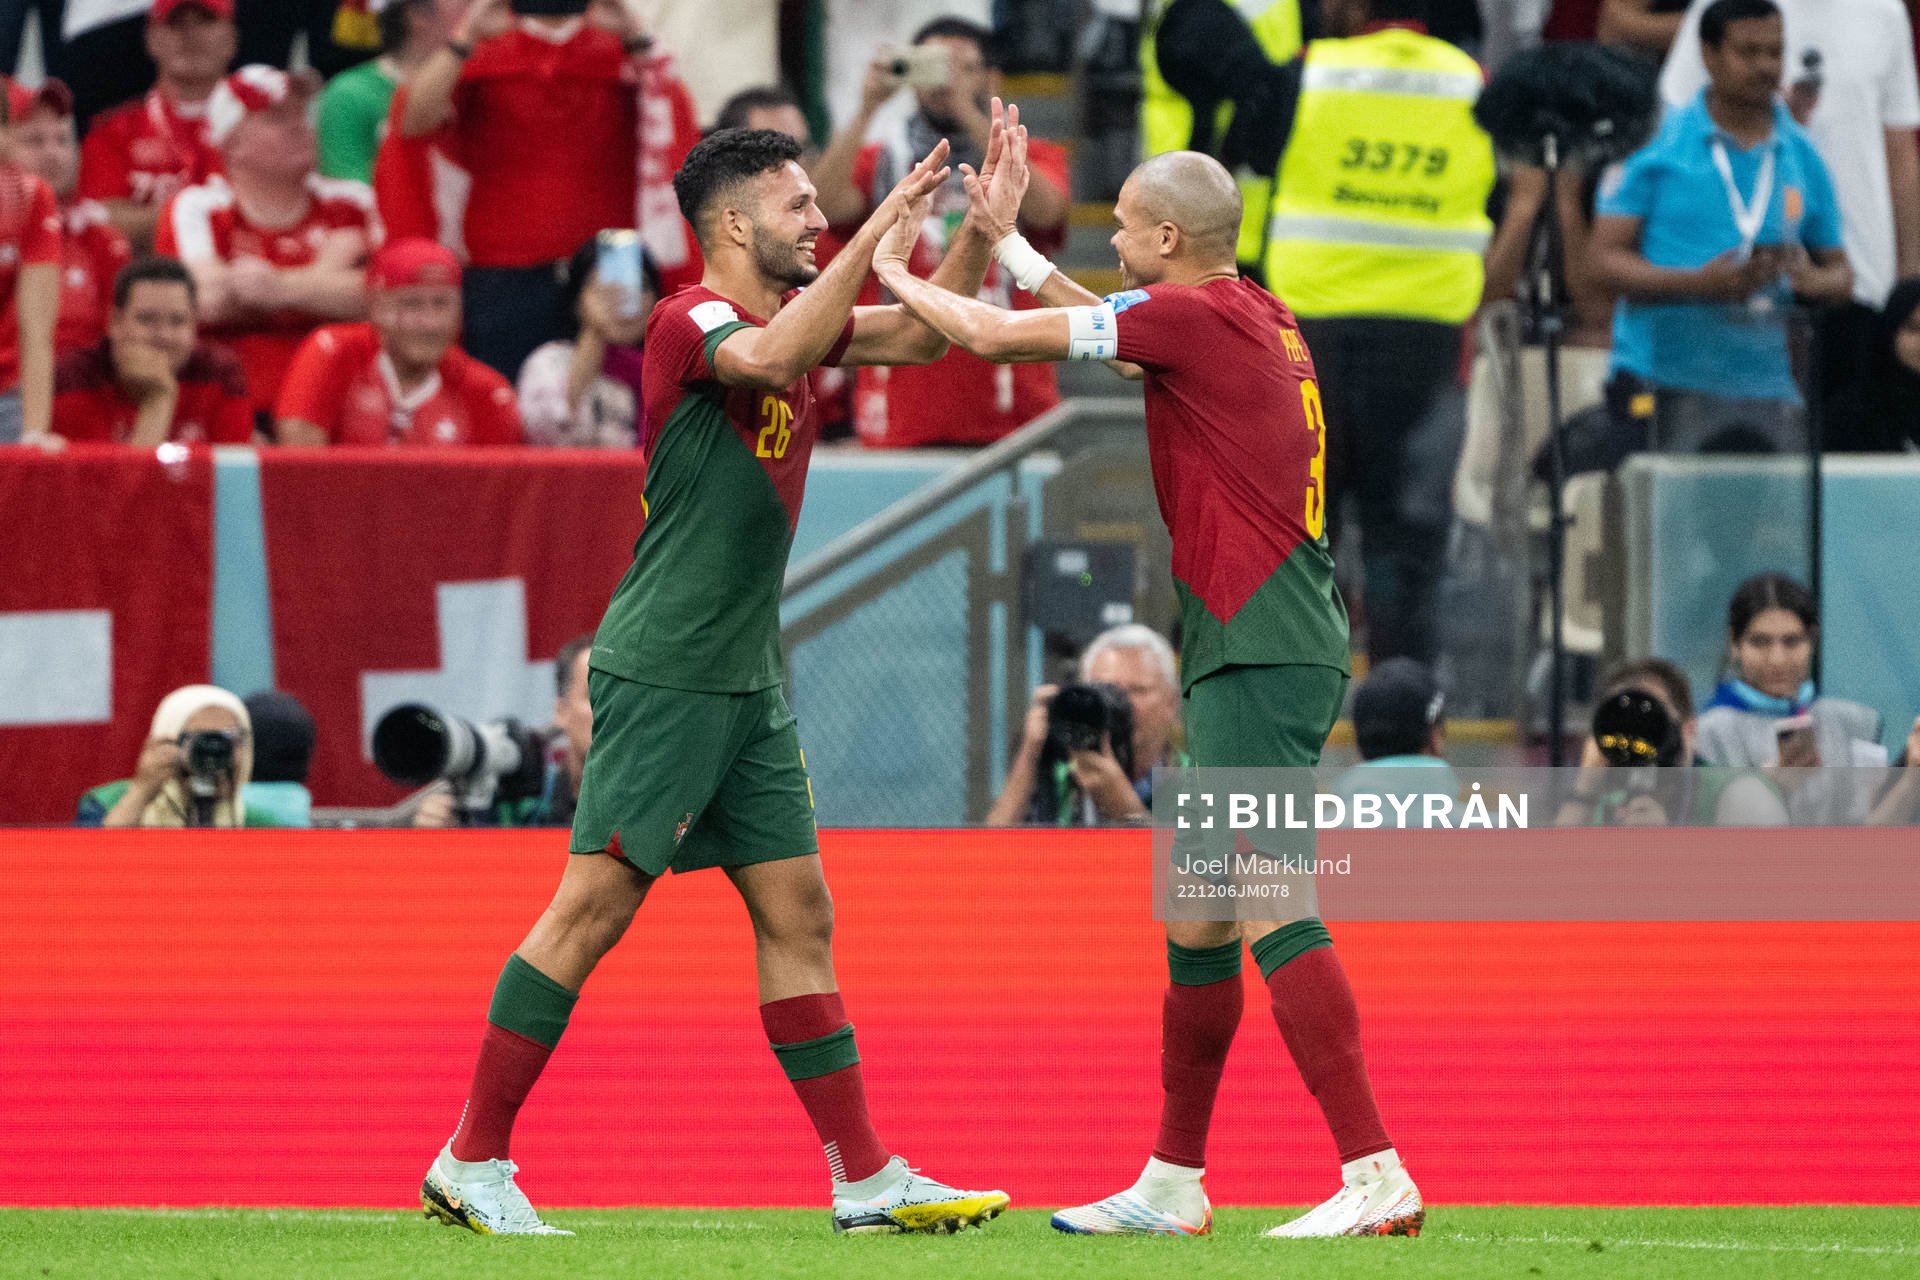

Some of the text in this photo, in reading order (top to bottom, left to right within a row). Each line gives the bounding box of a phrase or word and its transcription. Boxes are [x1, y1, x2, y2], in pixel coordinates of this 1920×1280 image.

[1341, 137, 1449, 177] 3379
[756, 395, 794, 459] 26
[1300, 378, 1326, 540] 3
